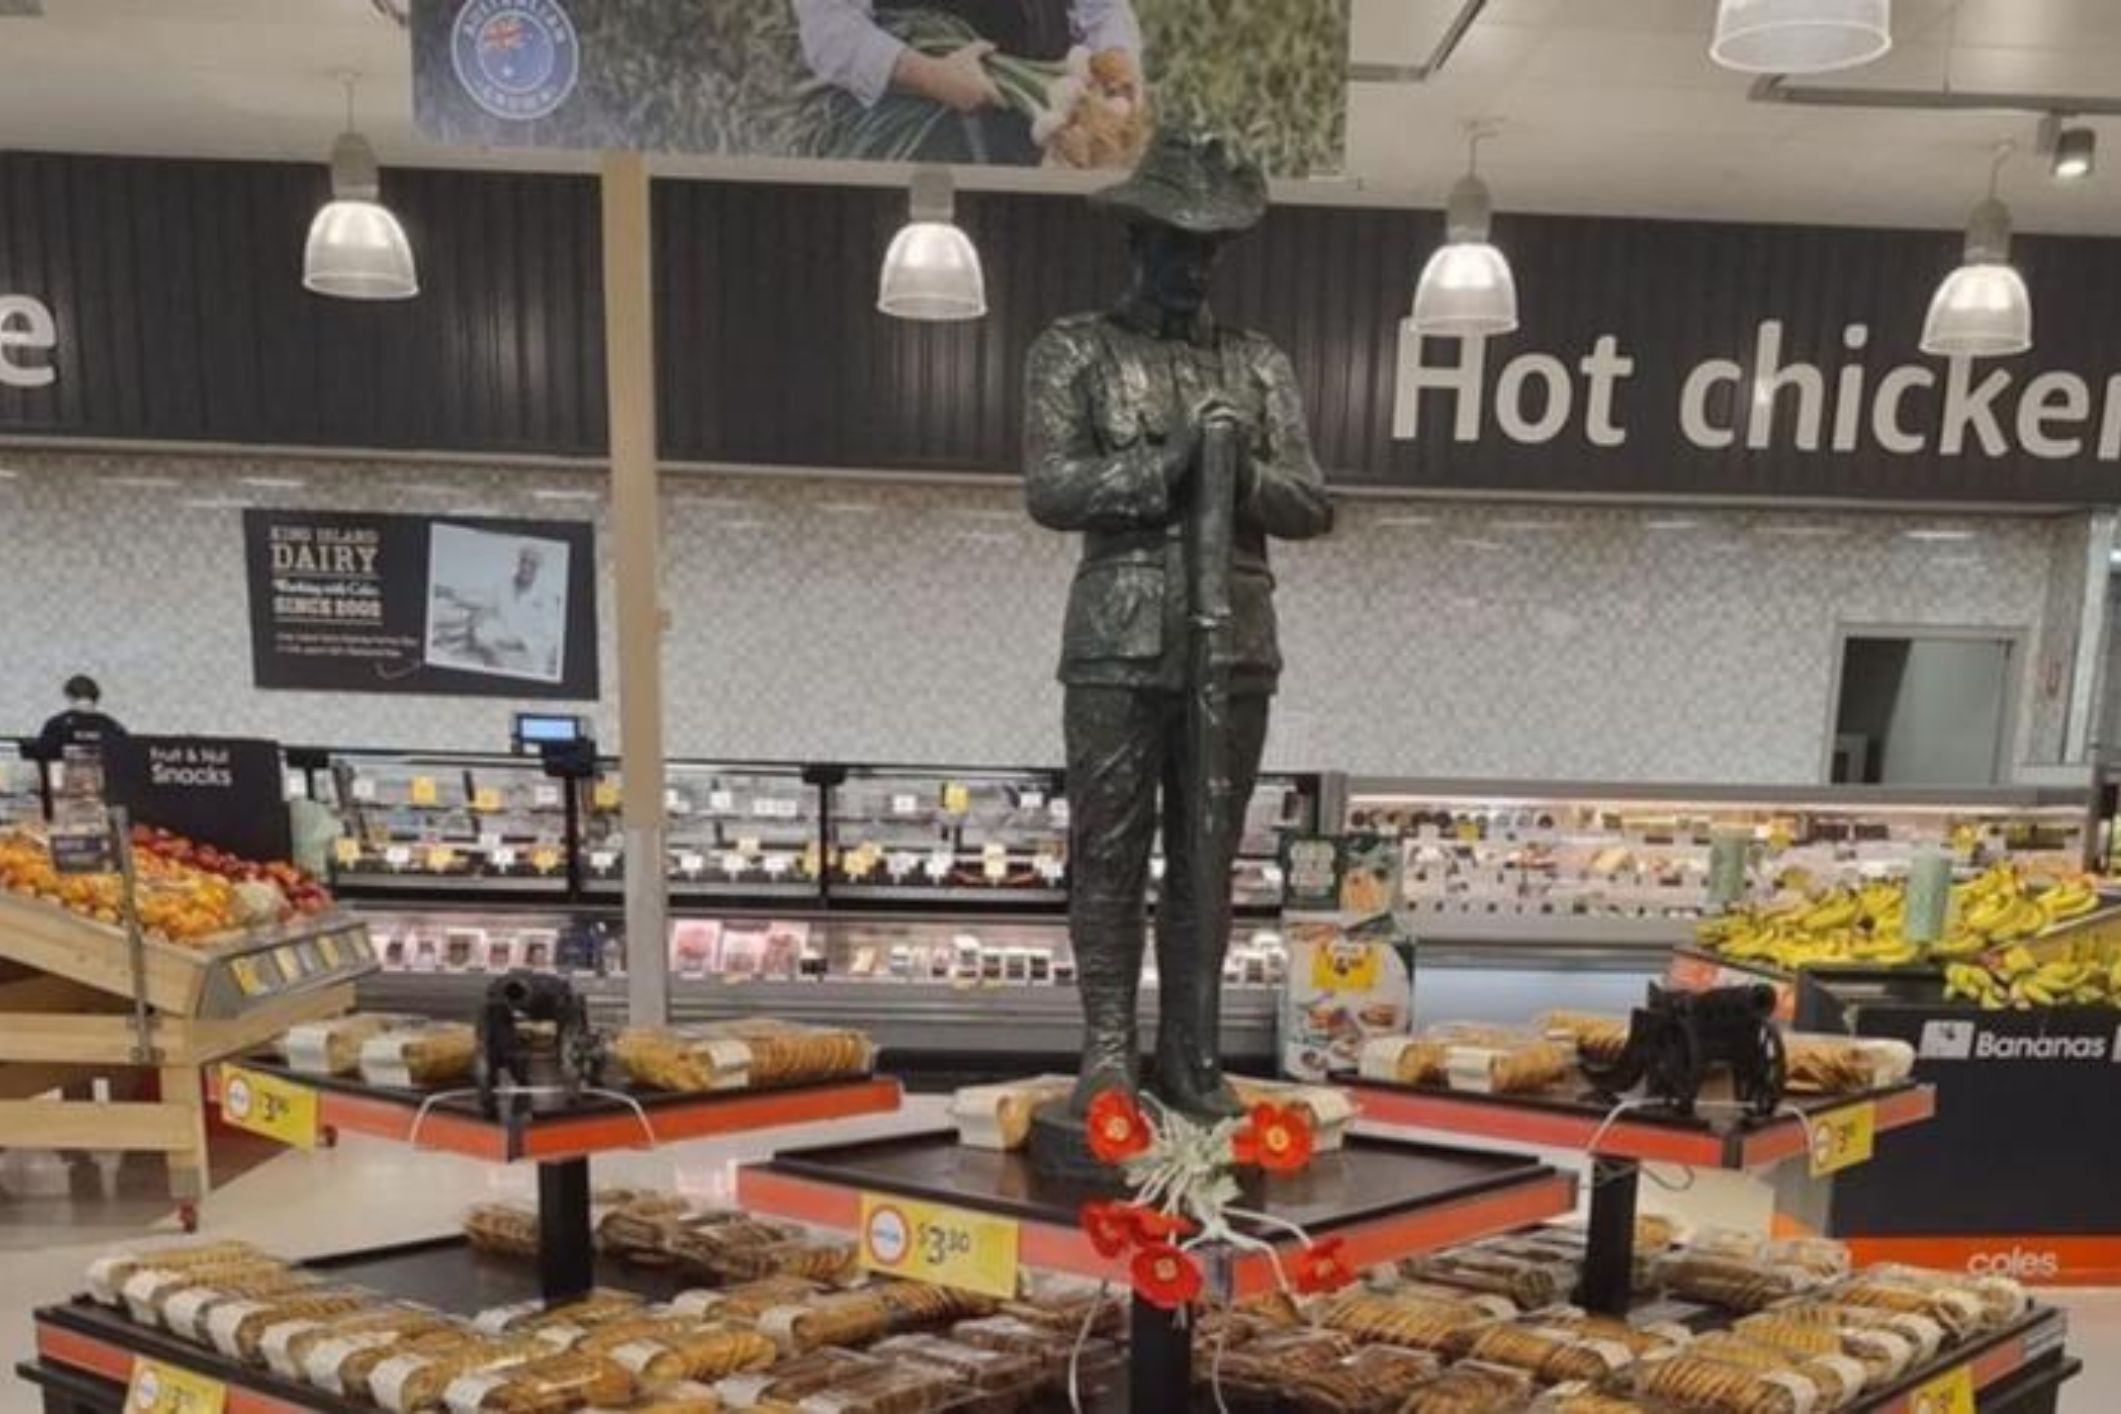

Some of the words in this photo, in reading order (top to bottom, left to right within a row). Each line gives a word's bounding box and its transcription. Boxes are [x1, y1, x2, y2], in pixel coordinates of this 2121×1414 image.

[1392, 315, 1635, 446] Hot
[1678, 319, 2121, 461] chicke
[270, 543, 379, 572] DAIRY
[151, 762, 233, 787] Snacks
[1974, 1030, 2108, 1059] Bananas
[1966, 1244, 2060, 1278] coles
